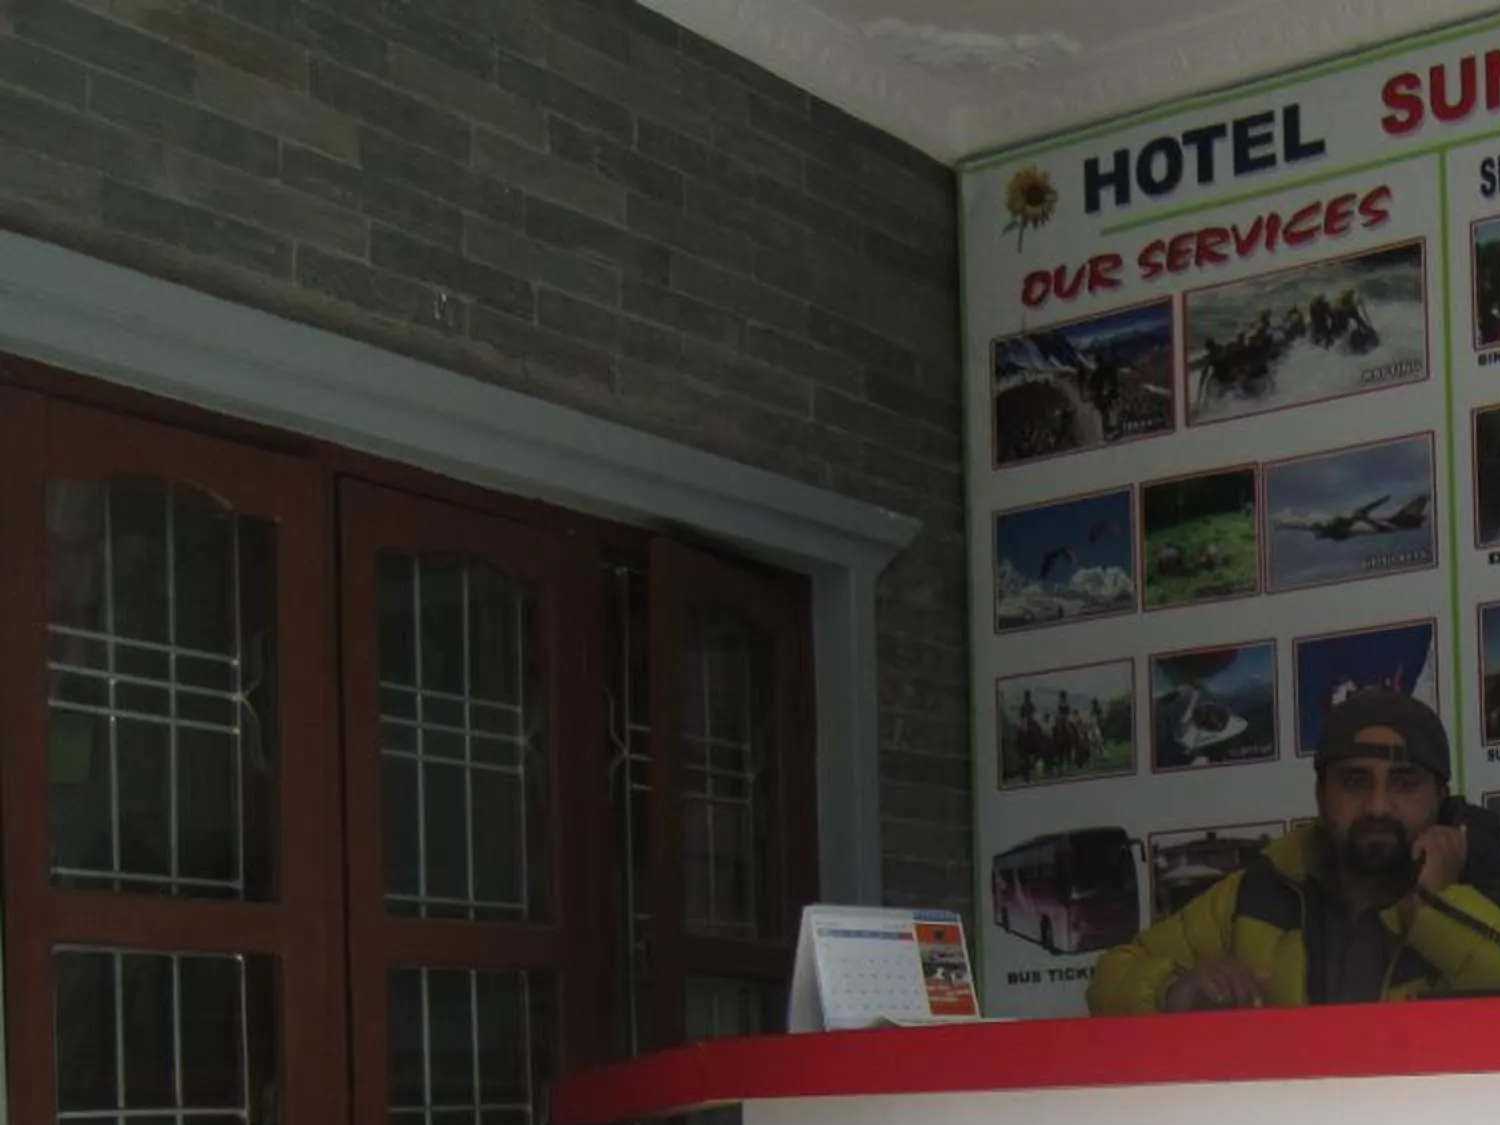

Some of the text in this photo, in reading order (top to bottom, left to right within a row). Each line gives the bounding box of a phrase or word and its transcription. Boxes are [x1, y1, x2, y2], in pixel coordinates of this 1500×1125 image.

[1083, 103, 1327, 214] HOTEL
[1021, 184, 1393, 308] OUR SERVICES
[1007, 970, 1042, 985] BUS
